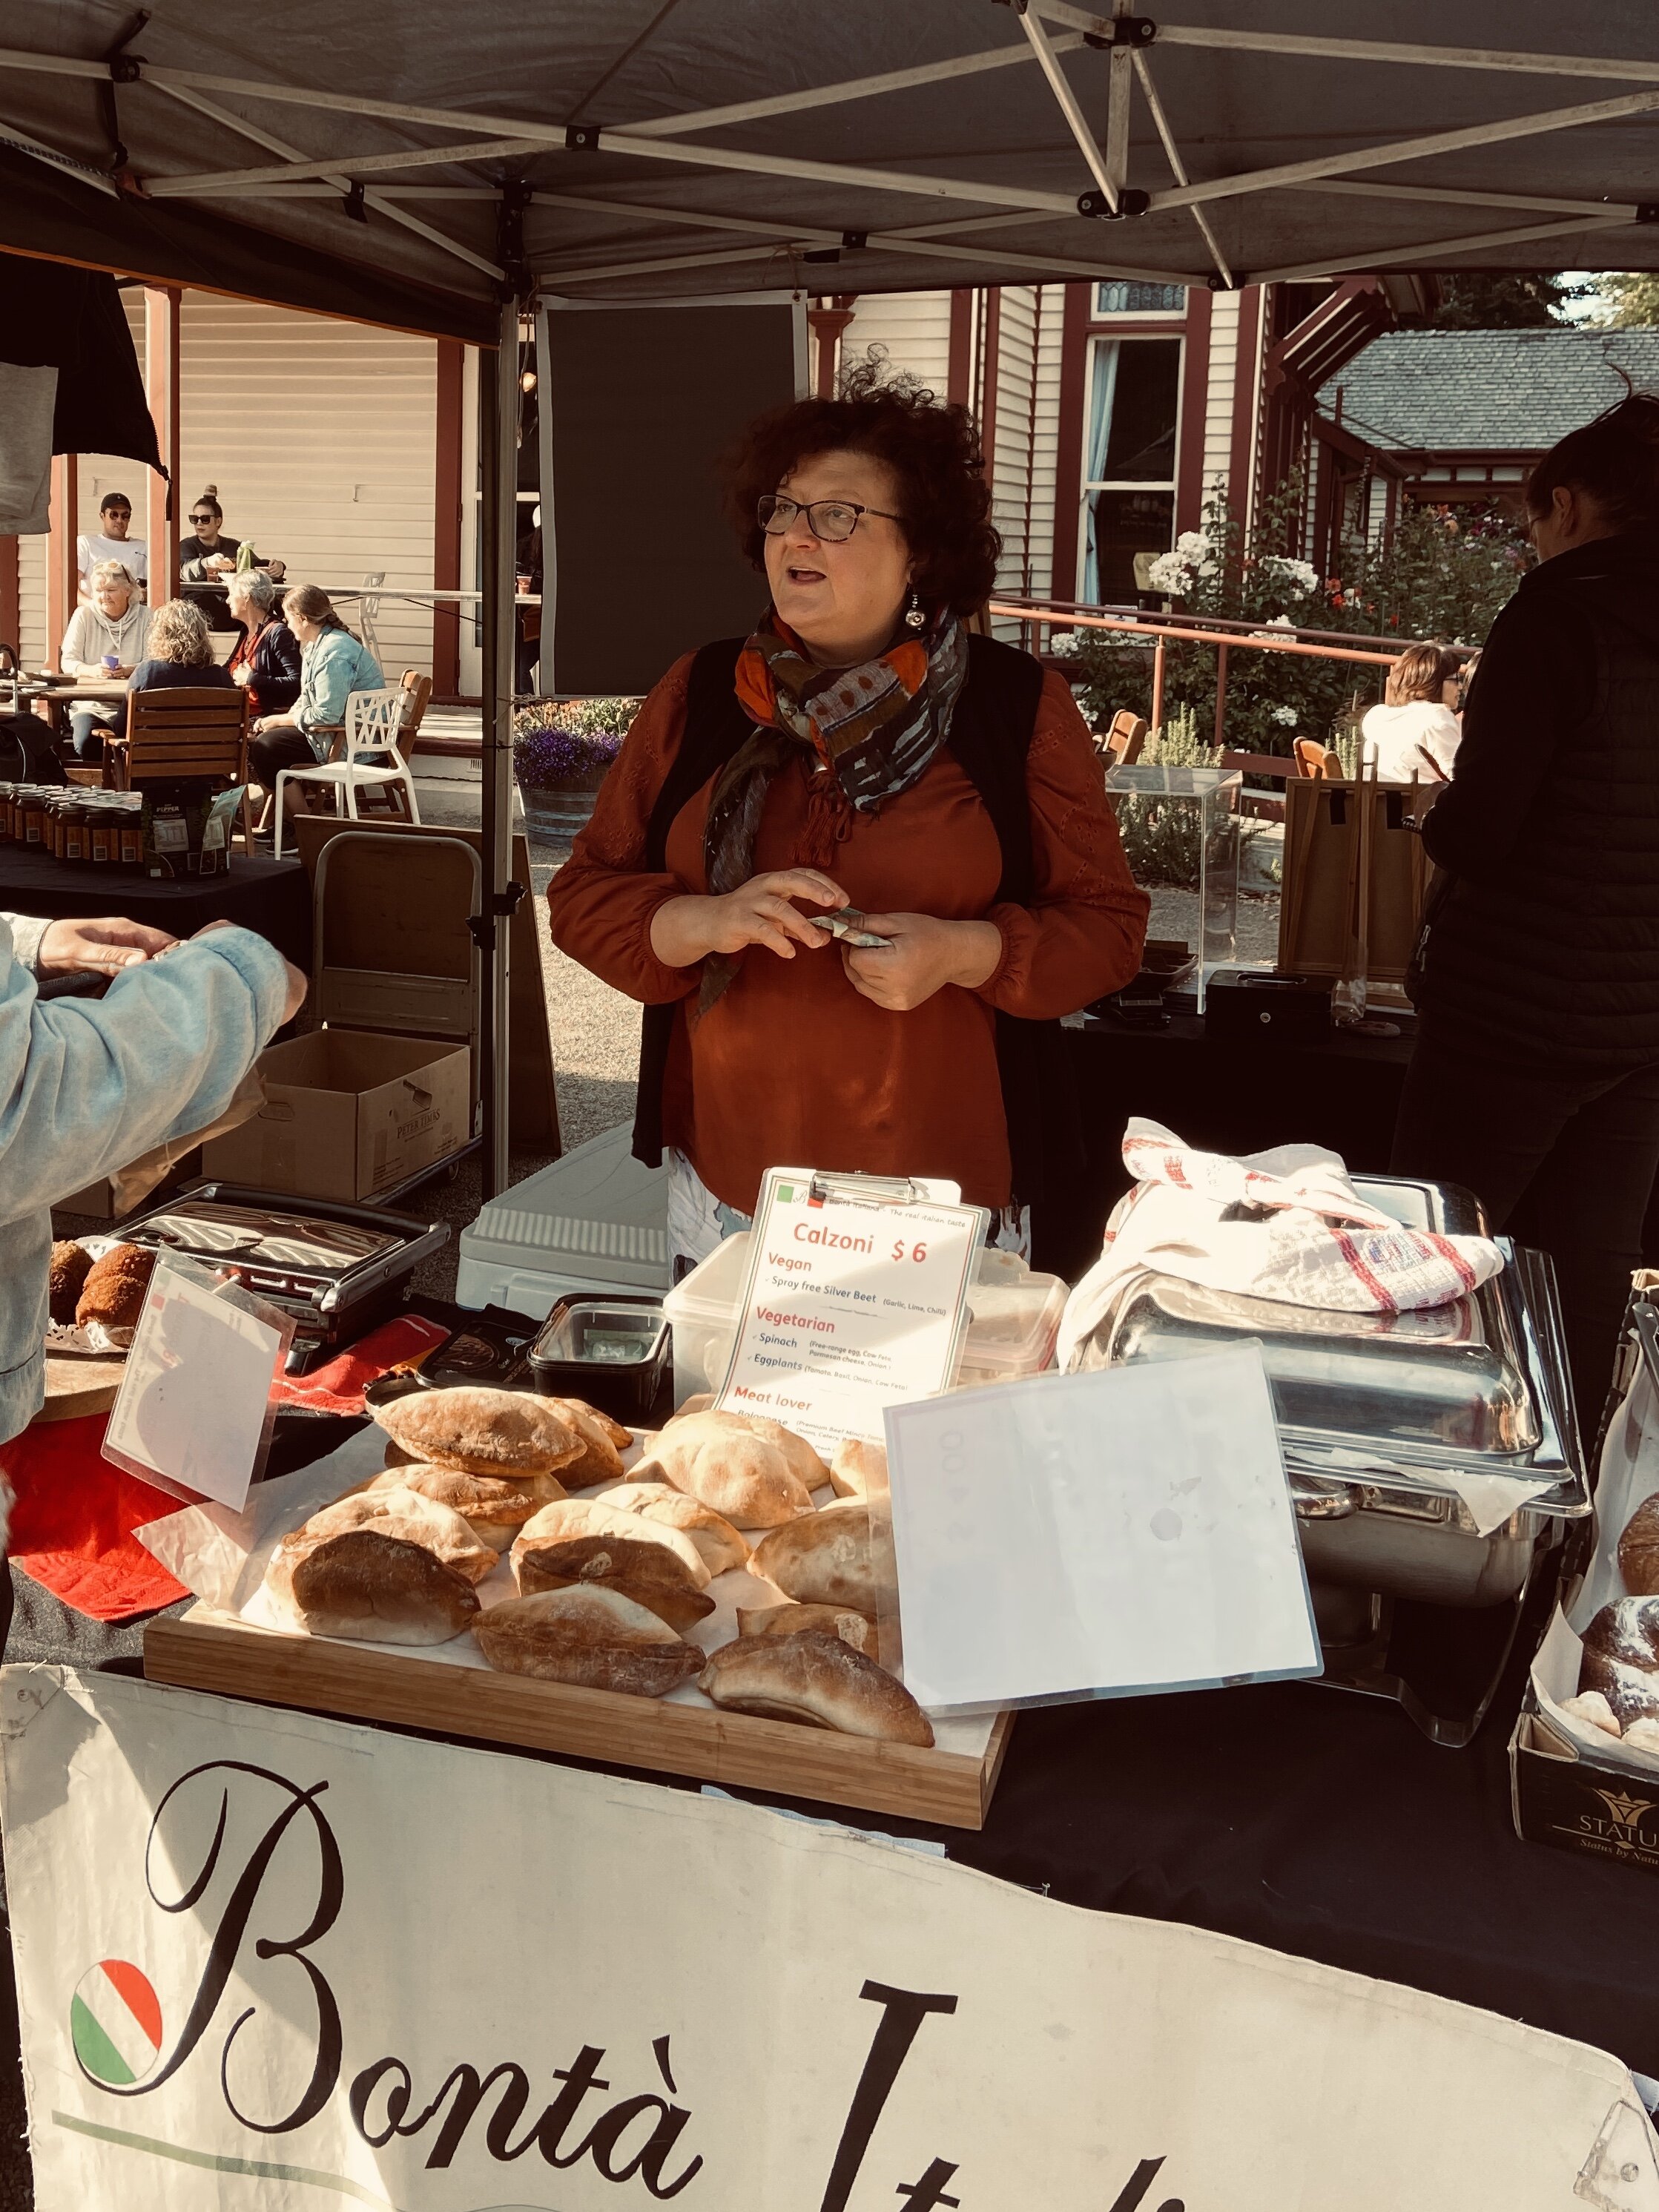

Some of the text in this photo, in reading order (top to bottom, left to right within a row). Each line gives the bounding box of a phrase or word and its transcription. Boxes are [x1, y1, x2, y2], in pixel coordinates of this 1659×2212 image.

[398, 1121, 418, 1139] PETER
[890, 1208, 903, 1217] The
[947, 1219, 966, 1228] taste
[794, 1223, 927, 1263] Calzoni $ 6
[768, 1251, 812, 1271] Vegan
[772, 1276, 799, 1289] Spray
[802, 1280, 821, 1293] free
[824, 1285, 851, 1299] Silver
[854, 1291, 877, 1303] Beet
[908, 1303, 925, 1313] Lime,
[756, 1306, 835, 1334] Vegetarian
[759, 1332, 797, 1349] Spinach
[863, 1350, 877, 1358] Cow
[809, 1349, 841, 1361] Parmesan
[754, 1353, 803, 1371] Eggplants
[734, 1386, 813, 1411] Meat lover
[1580, 1839, 1613, 1853] Status
[1616, 1847, 1629, 1859] by
[73, 1760, 703, 2200] Bontà
